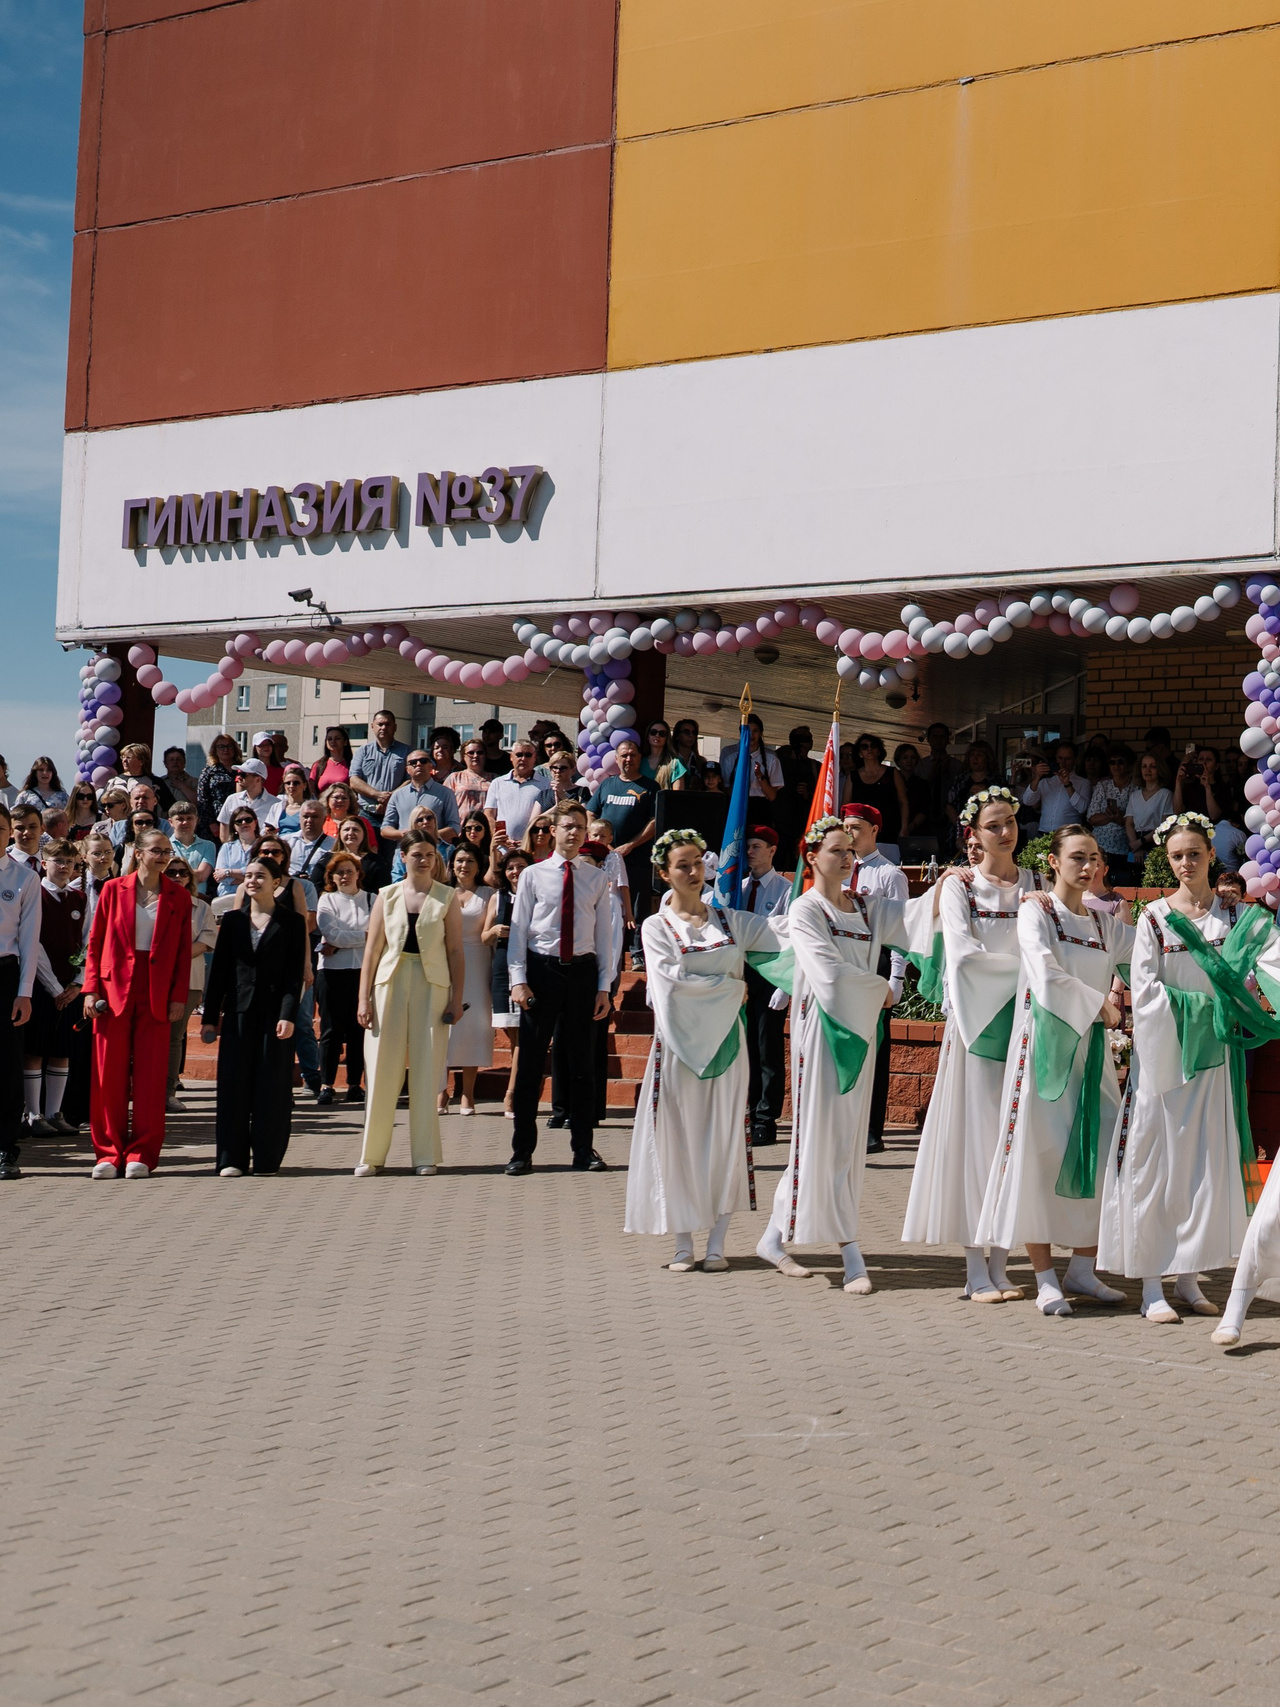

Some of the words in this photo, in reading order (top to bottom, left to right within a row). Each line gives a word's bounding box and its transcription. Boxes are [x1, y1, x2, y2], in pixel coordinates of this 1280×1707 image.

[122, 475, 398, 549] ГИМНАЗИЯ
[415, 464, 542, 527] №37
[606, 794, 636, 806] PUMA
